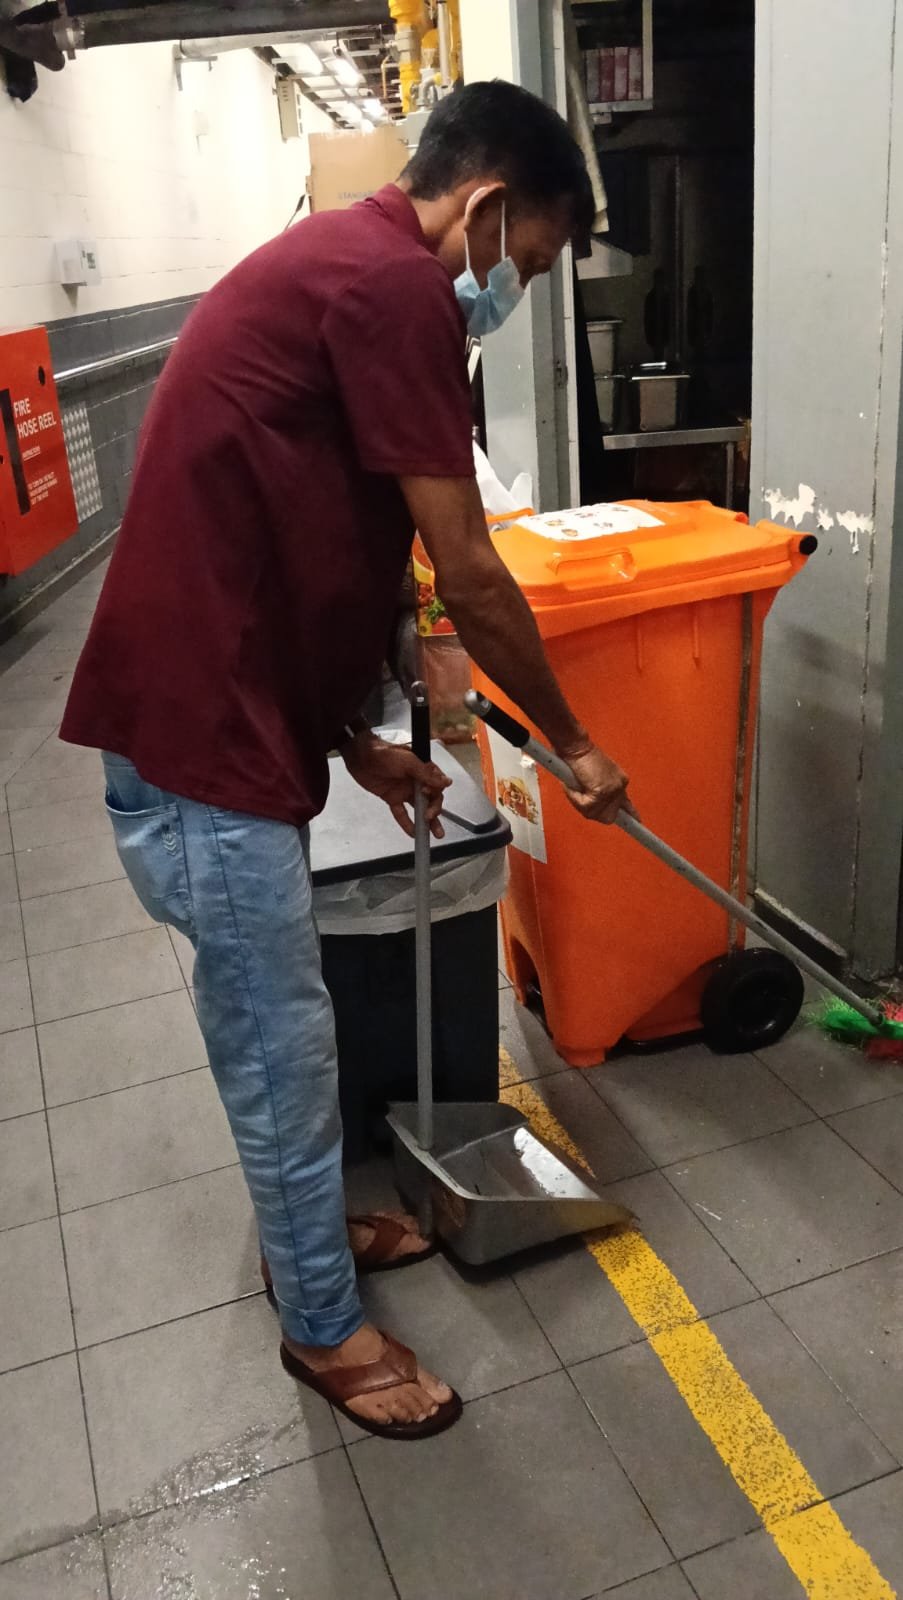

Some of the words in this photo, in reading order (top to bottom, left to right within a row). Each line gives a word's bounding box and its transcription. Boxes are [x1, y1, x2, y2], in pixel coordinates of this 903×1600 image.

[13, 397, 31, 418] FIRE
[17, 418, 38, 439] HOSE
[38, 411, 57, 430] REEL
